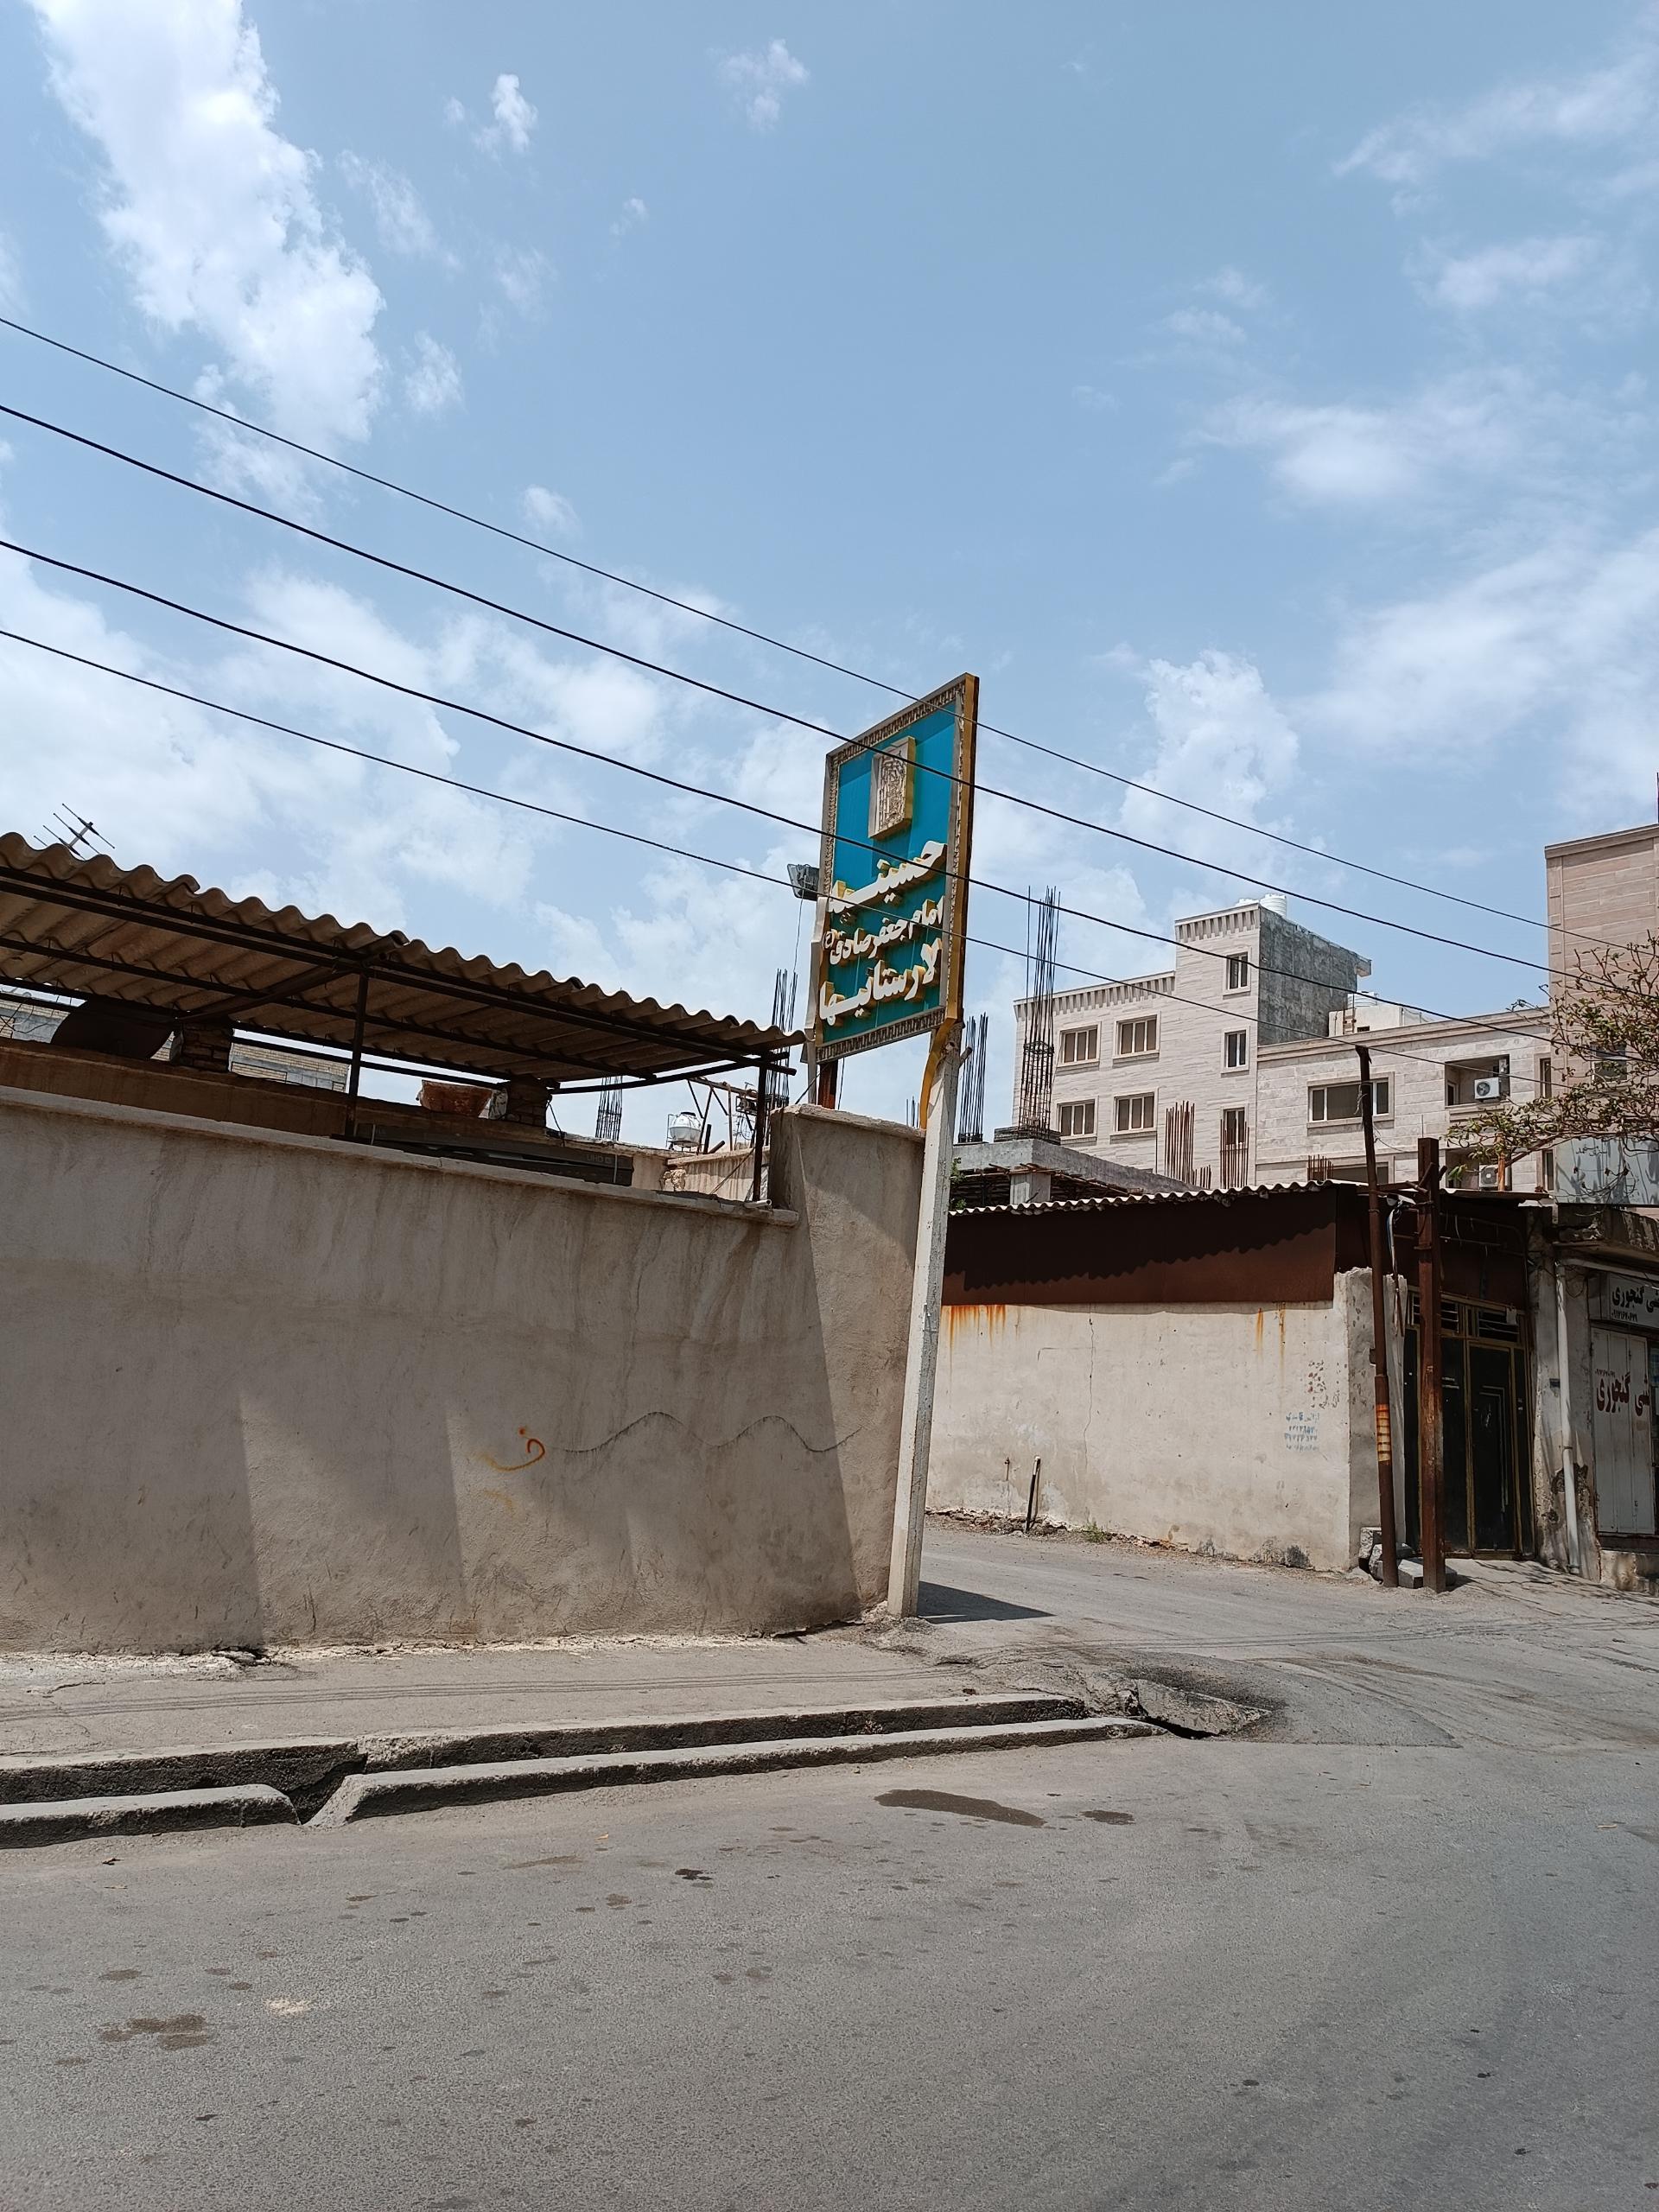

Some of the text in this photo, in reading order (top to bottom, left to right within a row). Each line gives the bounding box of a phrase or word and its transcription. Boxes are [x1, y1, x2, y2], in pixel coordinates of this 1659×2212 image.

[828, 840, 947, 925] حسینیه
[868, 917, 909, 959] جعفر
[908, 895, 944, 940] امام
[830, 928, 875, 965] صادق
[1611, 1286, 1644, 1308] گنجوری
[1596, 1371, 1630, 1414] گنجوری
